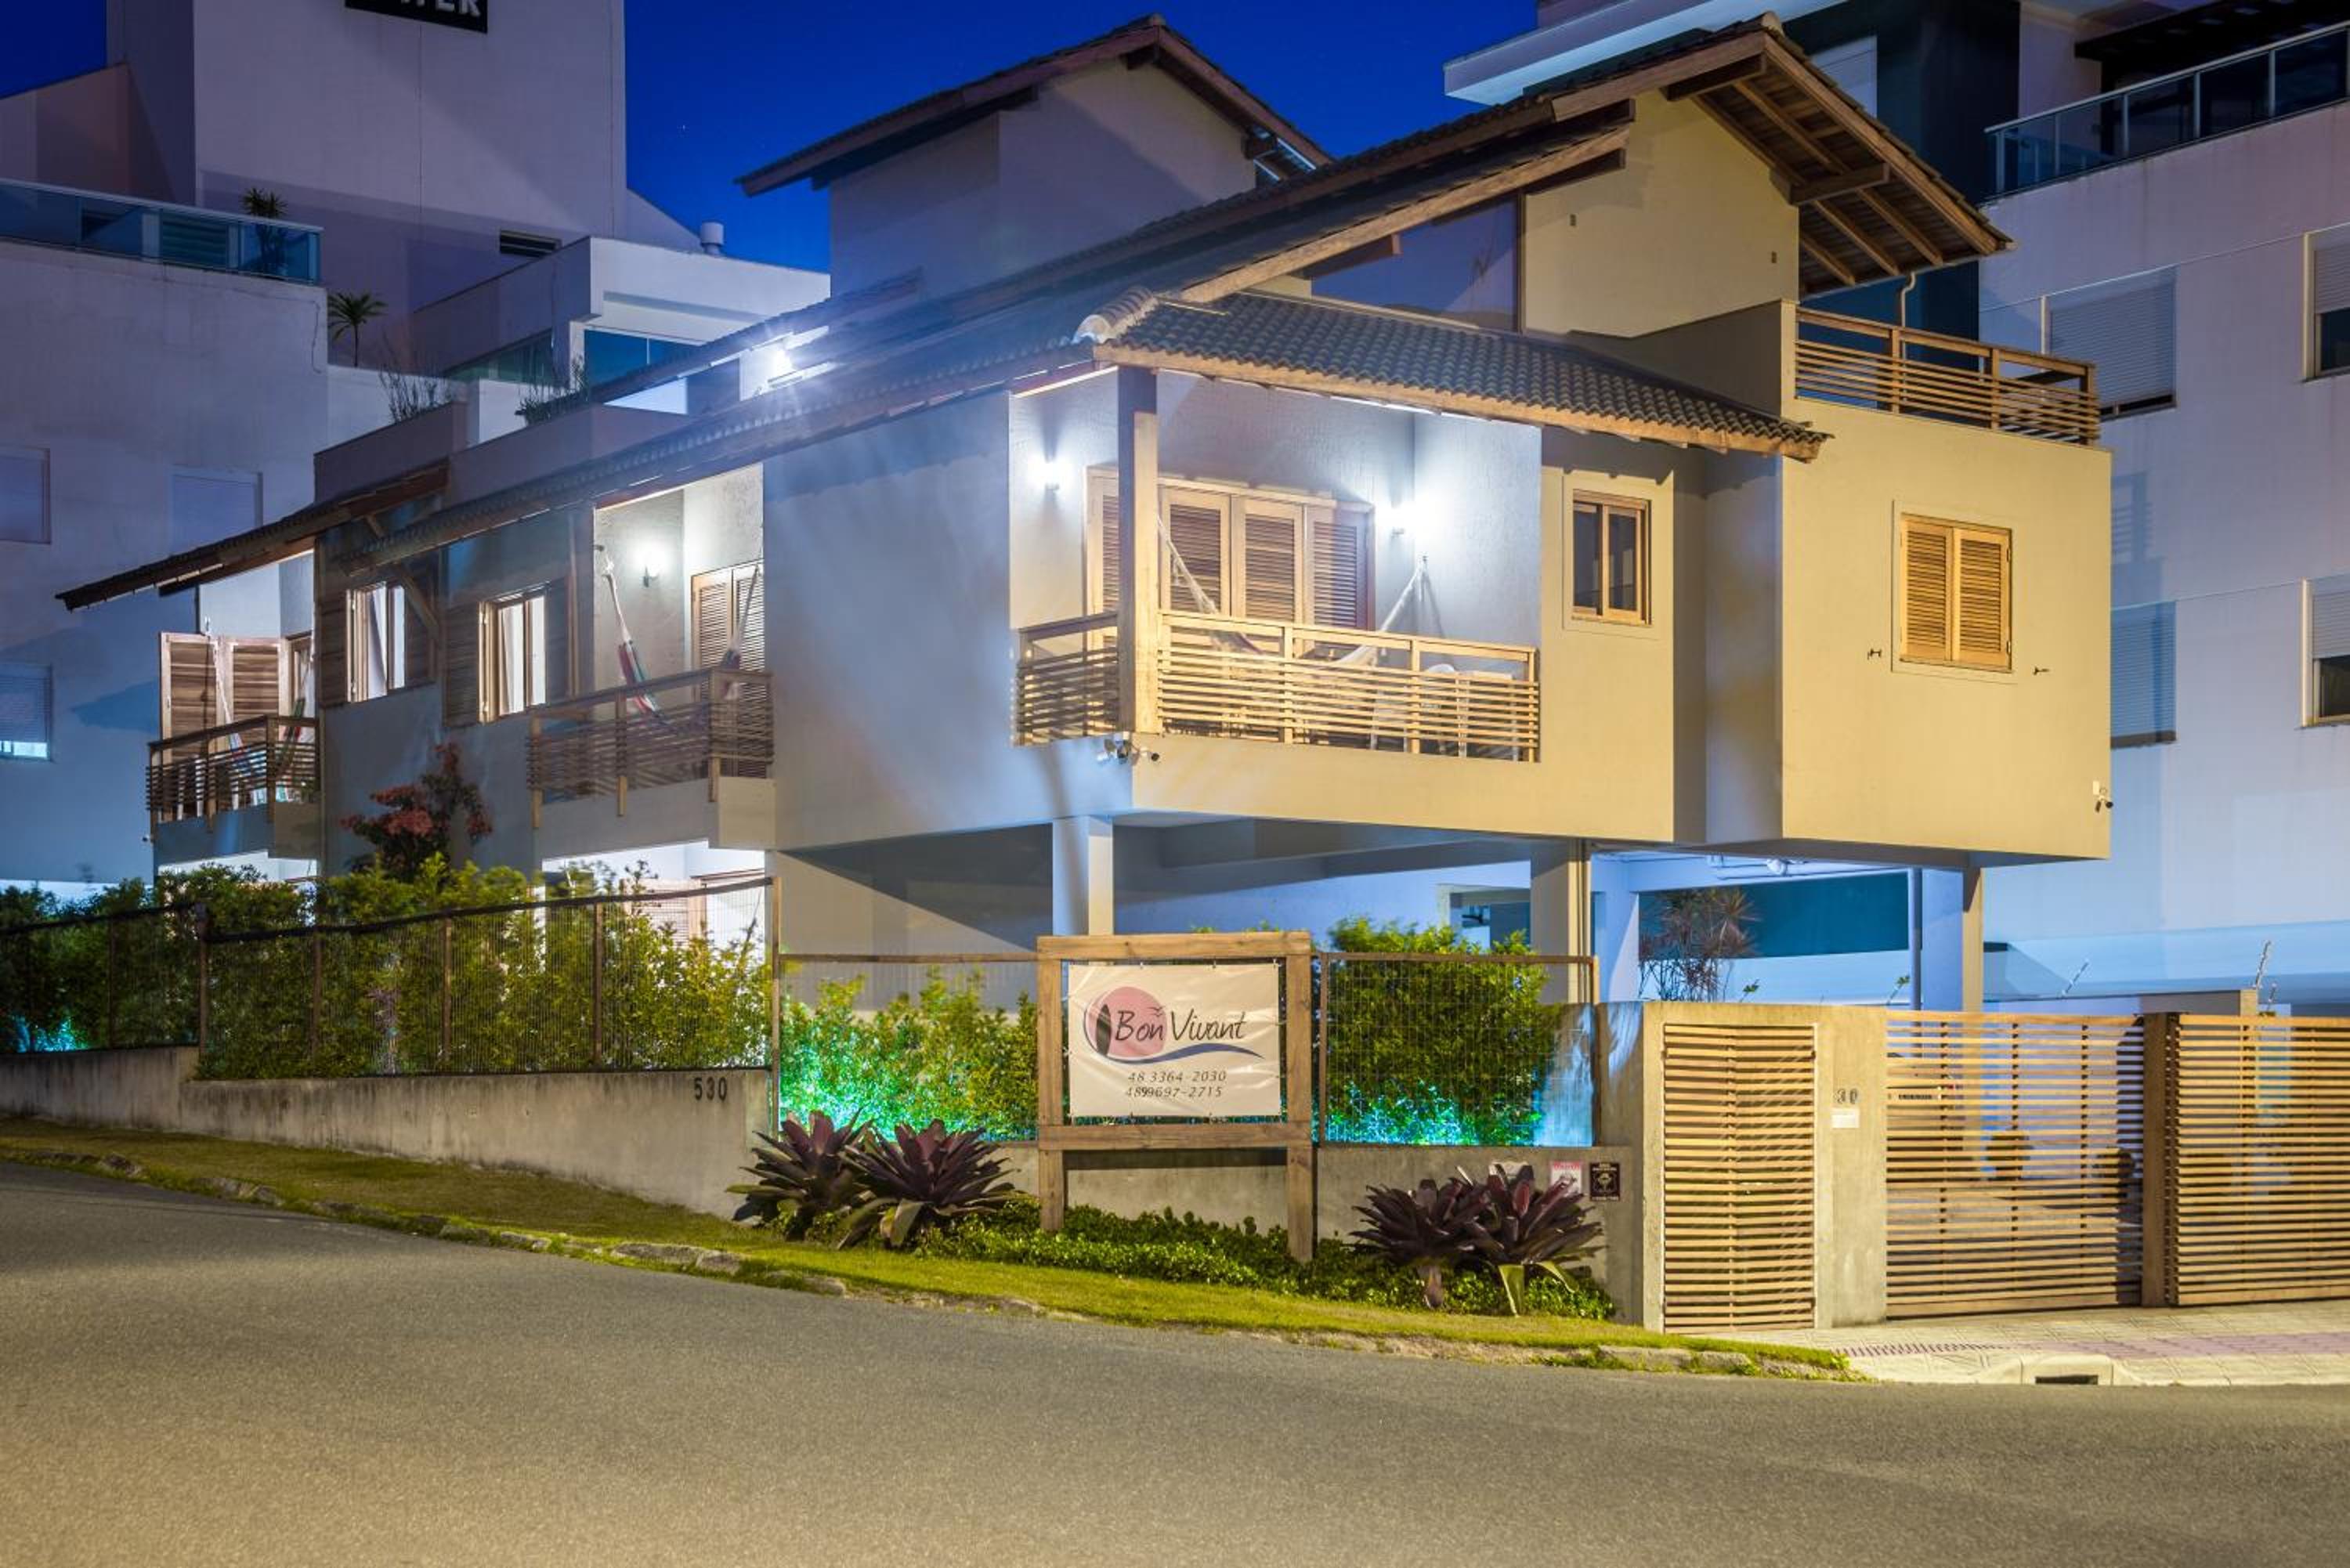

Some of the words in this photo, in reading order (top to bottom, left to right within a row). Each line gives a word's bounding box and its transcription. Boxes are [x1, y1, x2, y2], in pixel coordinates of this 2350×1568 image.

[1115, 1010, 1164, 1041] Bon
[1171, 1009, 1246, 1041] Vivant
[694, 1076, 727, 1100] 530
